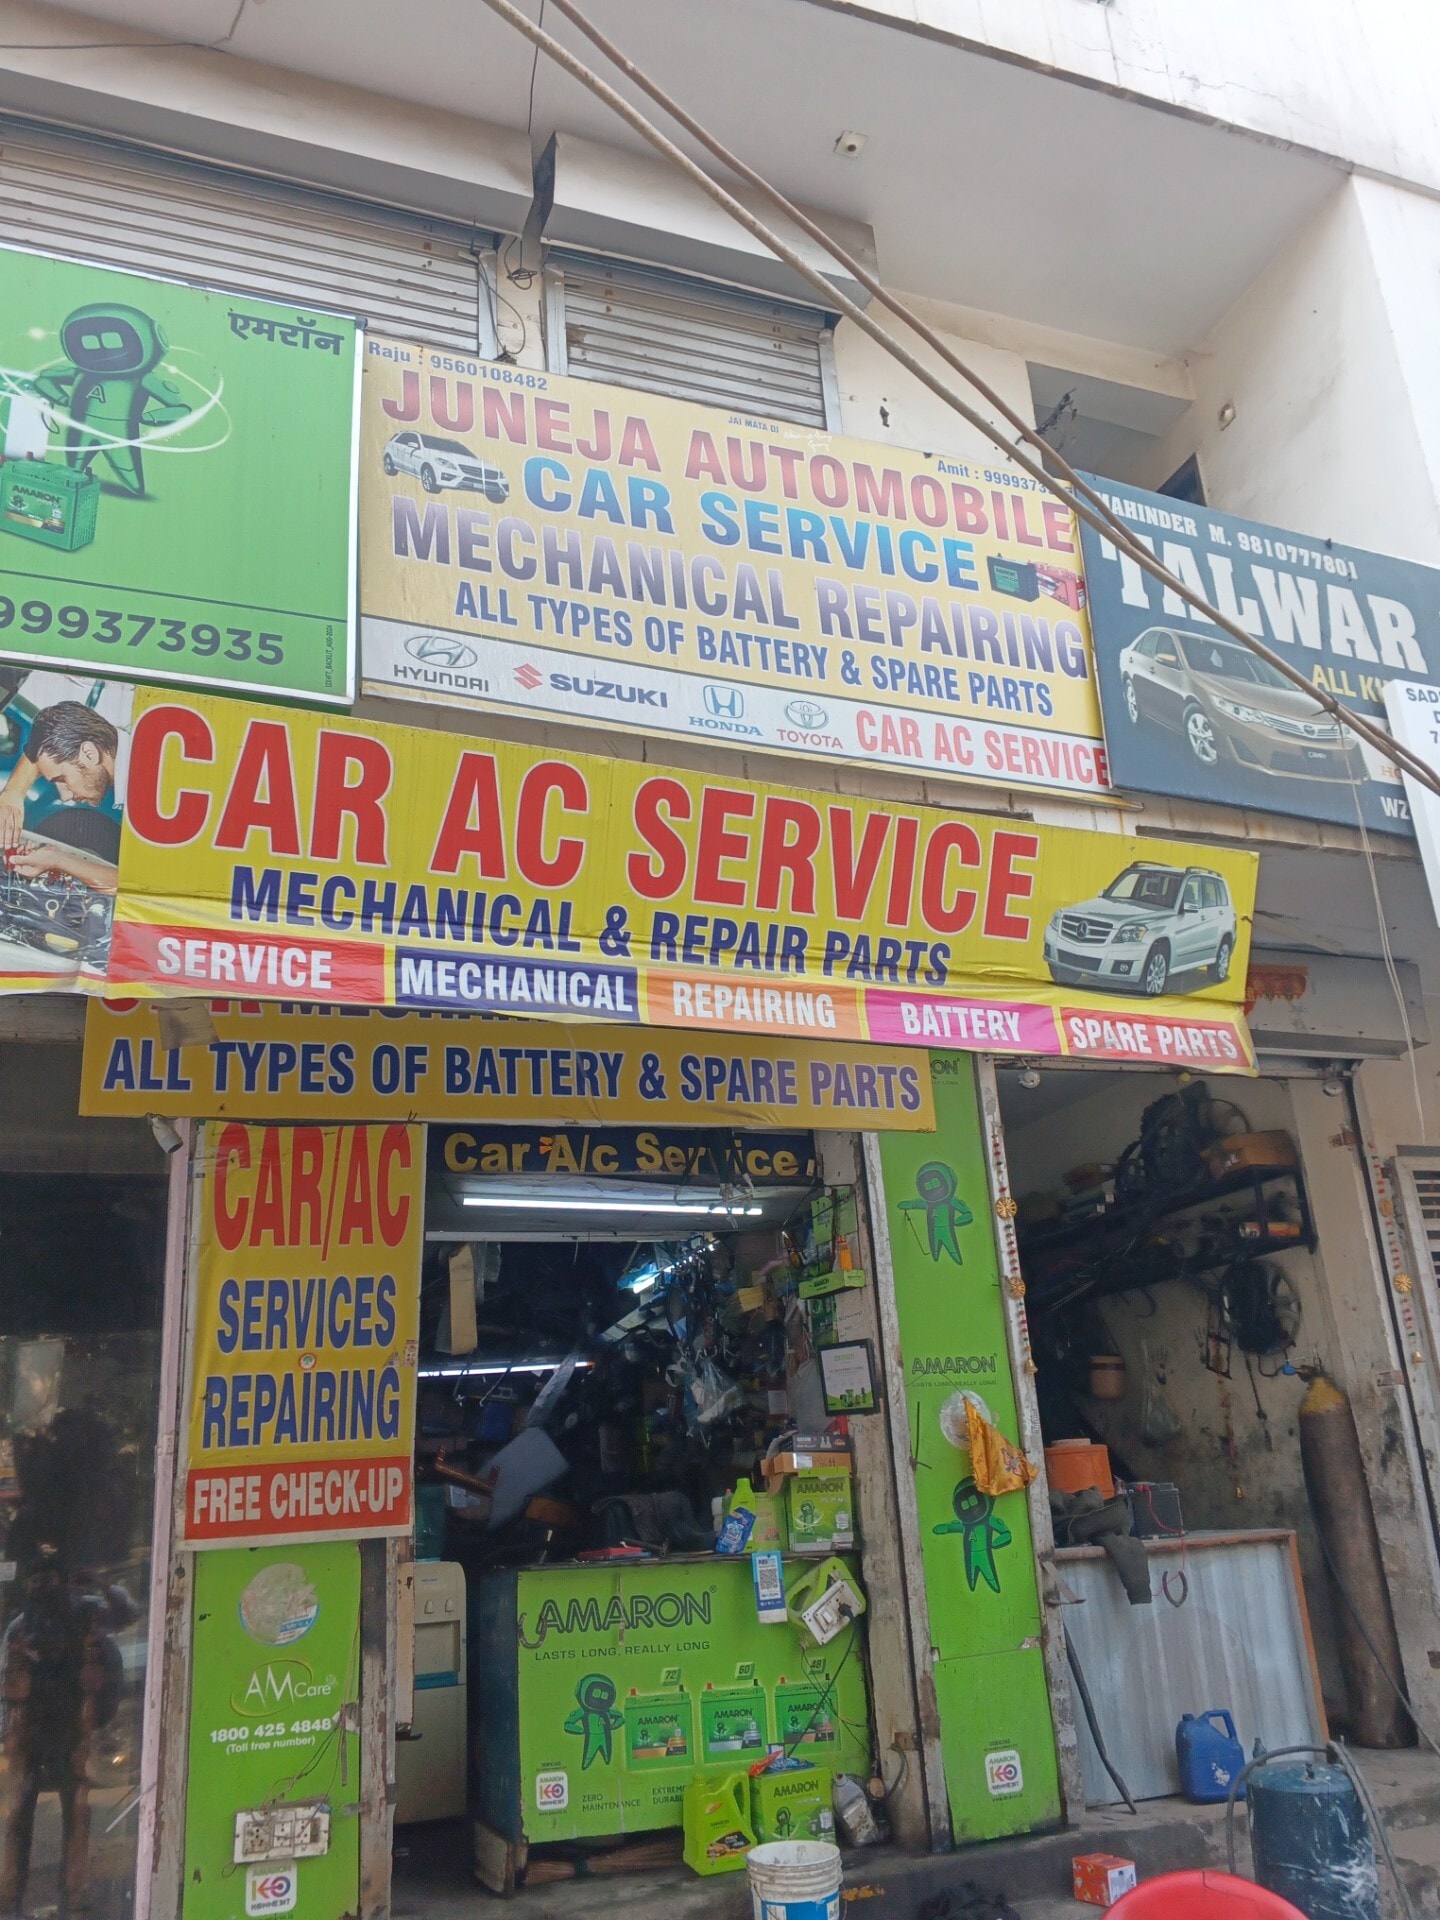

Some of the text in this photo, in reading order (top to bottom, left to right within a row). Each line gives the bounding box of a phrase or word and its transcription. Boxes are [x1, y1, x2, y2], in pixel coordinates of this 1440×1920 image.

[228, 309, 344, 355] एमरॉन
[369, 341, 411, 363] Raju
[430, 355, 548, 391] 9560108482
[382, 369, 1075, 554] JUNEJA AUTOMOBILE
[937, 460, 970, 478] Amit
[523, 456, 979, 591] CAR SERVICE
[1208, 523, 1232, 546] M.
[1237, 531, 1359, 580] 9810777801
[392, 495, 1088, 679] MECHANICAL REPAIRING
[1100, 526, 1429, 674] TALWAR
[455, 581, 1053, 717] ALL TYPES OF BATTERY & SPARE PARTS
[394, 664, 489, 692] HYUNDAI
[550, 673, 667, 708] SUZUKI
[1312, 664, 1357, 698] ALL
[689, 716, 763, 736] HONDA
[777, 729, 843, 749] TOYOTA
[856, 710, 1109, 787] CAR AC SERVICE
[126, 703, 1039, 942] CAR AC SERVICE
[230, 864, 951, 988] MECHANICAL & REPAIR PARTS
[157, 937, 332, 989] SERVICE
[400, 956, 633, 1013] MECHANICAL
[673, 981, 837, 1029] REPAIRING
[901, 1001, 1021, 1042] BATTERY
[1070, 1016, 1152, 1055] SPARE
[1159, 1025, 1238, 1060] PARTS
[102, 1038, 921, 1112] ALL TYPES OF BATTERY & SPARE PARTS
[444, 1132, 530, 1173] Car
[546, 1134, 620, 1173] A/c
[213, 1124, 412, 1263] CAR/AC
[217, 1274, 397, 1354] SERVICES
[912, 1355, 997, 1375] AMARON
[202, 1366, 400, 1449] REPAIRING
[193, 1466, 404, 1525] FREE CHECK-UP
[797, 1483, 844, 1494] AMARON
[536, 1590, 712, 1634] AMARON
[535, 1641, 710, 1661] LASTS LONG, REALLY LONG
[638, 1715, 678, 1726] AMARON
[714, 1709, 752, 1719] AMARON
[787, 1702, 825, 1713] AMARON
[210, 1718, 332, 1743] 1800 425 4848
[226, 1735, 316, 1755] (Toll free number)
[582, 1794, 603, 1803] ZERO
[582, 1799, 640, 1812] MAINTENANCE
[773, 1780, 819, 1798] AMARON
